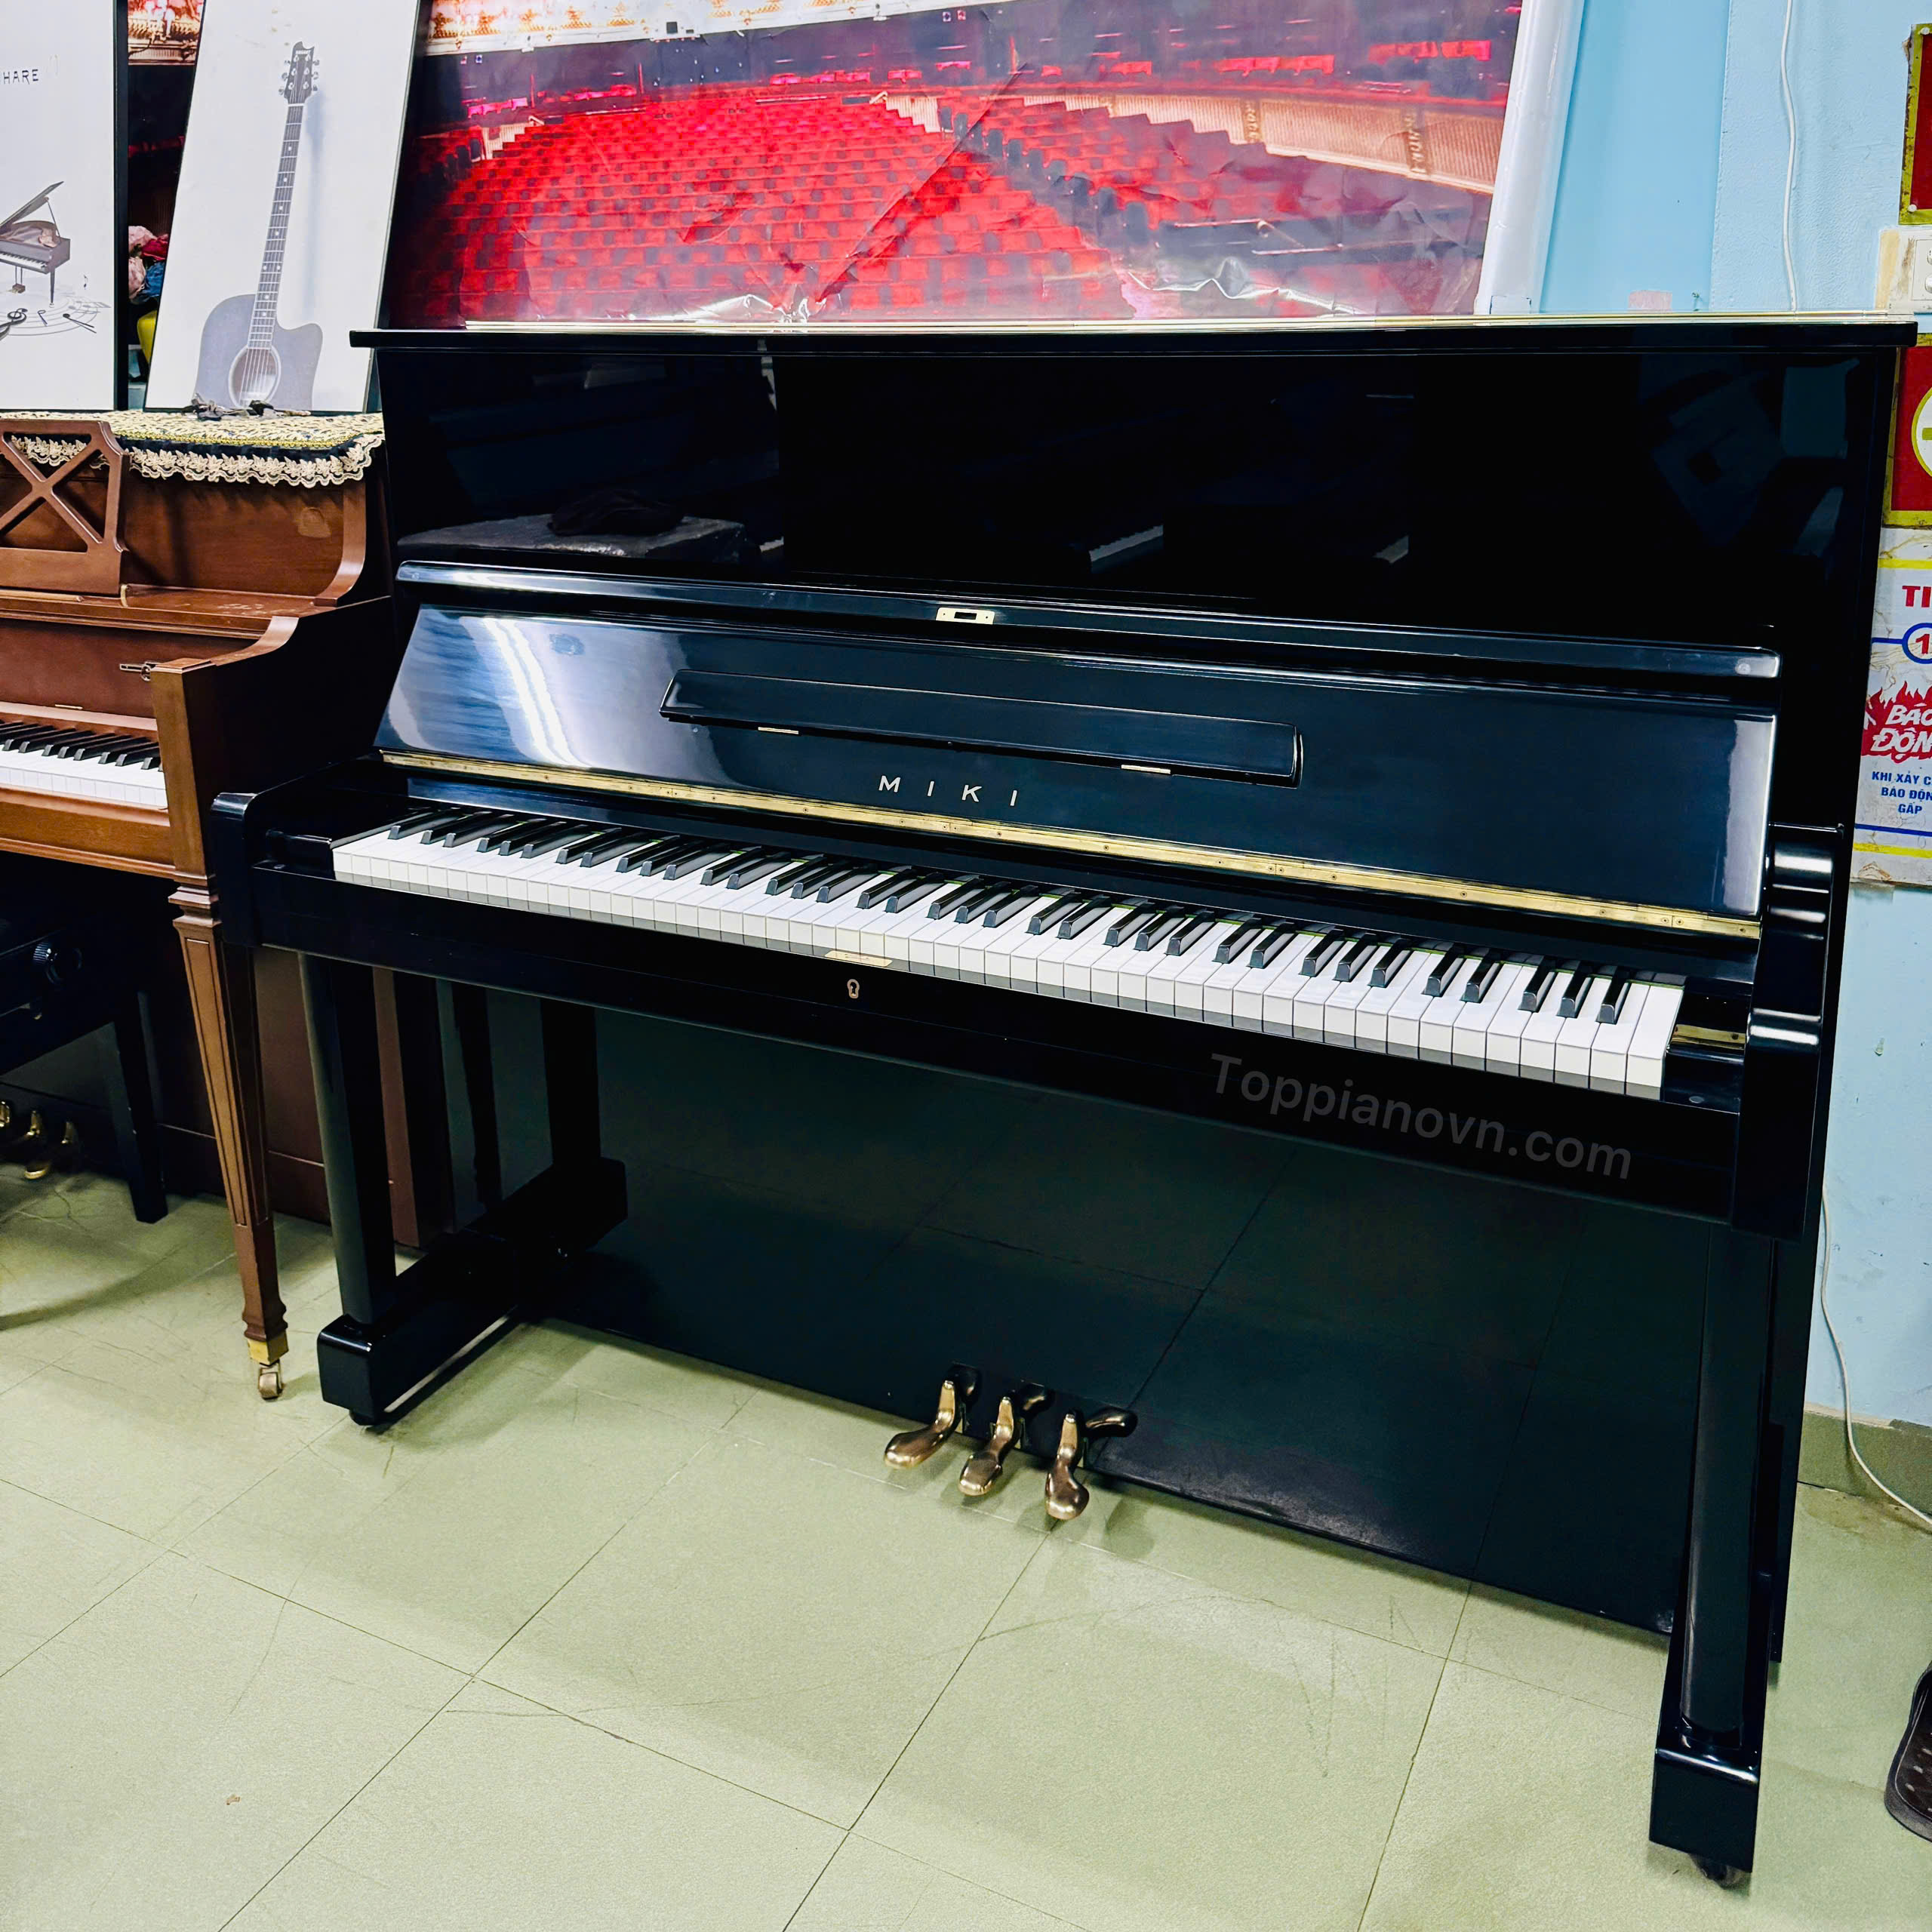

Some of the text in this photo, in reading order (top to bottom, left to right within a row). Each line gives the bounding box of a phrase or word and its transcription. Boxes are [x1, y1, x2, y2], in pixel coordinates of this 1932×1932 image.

[1872, 771, 1893, 782] KHI
[878, 775, 1018, 807] MIKI
[1881, 786, 1906, 798] BÁO
[1898, 801, 1922, 814] GẤP
